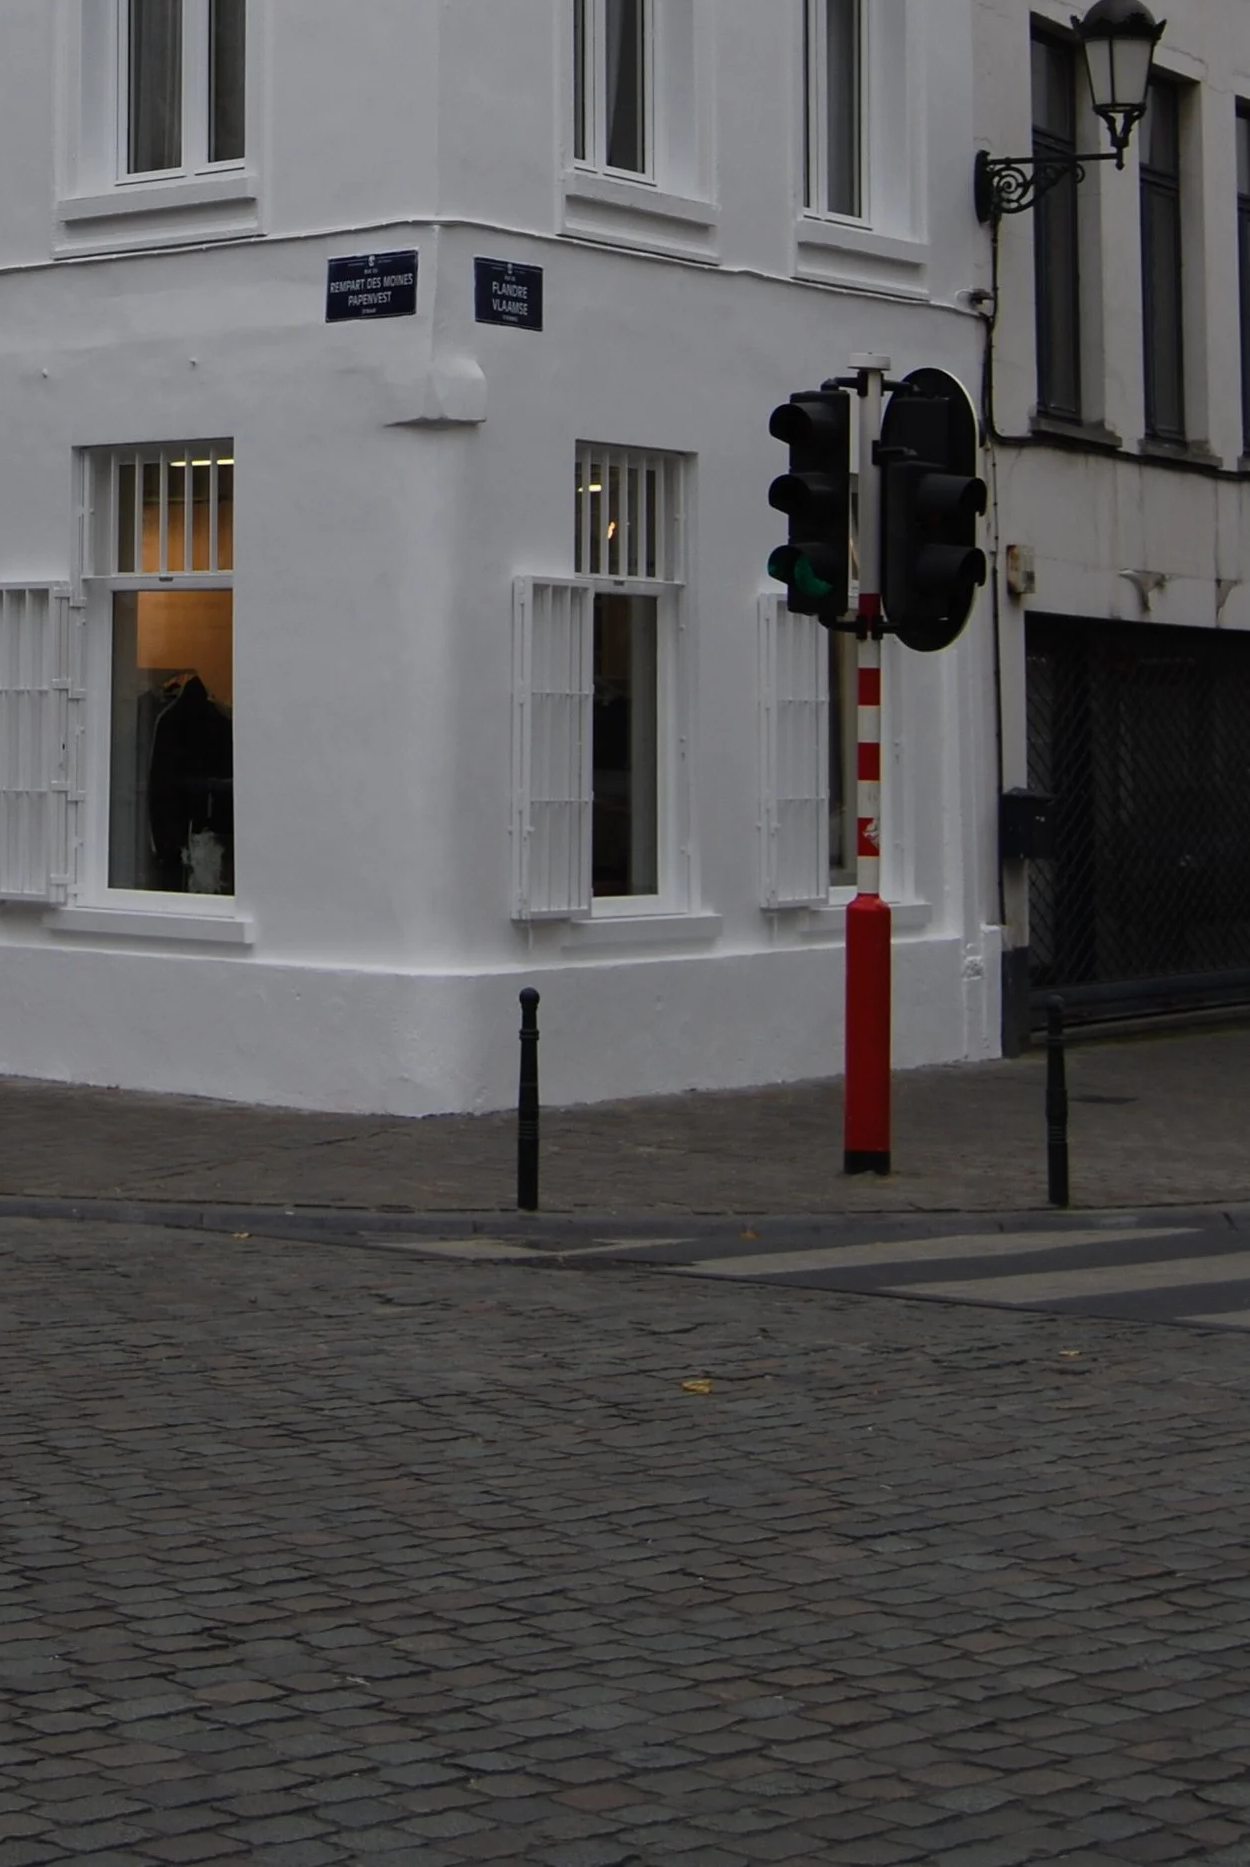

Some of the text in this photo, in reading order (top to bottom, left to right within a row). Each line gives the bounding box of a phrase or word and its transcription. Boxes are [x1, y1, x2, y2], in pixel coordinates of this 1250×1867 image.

[330, 273, 413, 293] REMPART DES MOINES
[492, 281, 528, 299] FLANDRE
[348, 291, 392, 307] PAPENVEST
[492, 298, 528, 315] VLAAMSE
